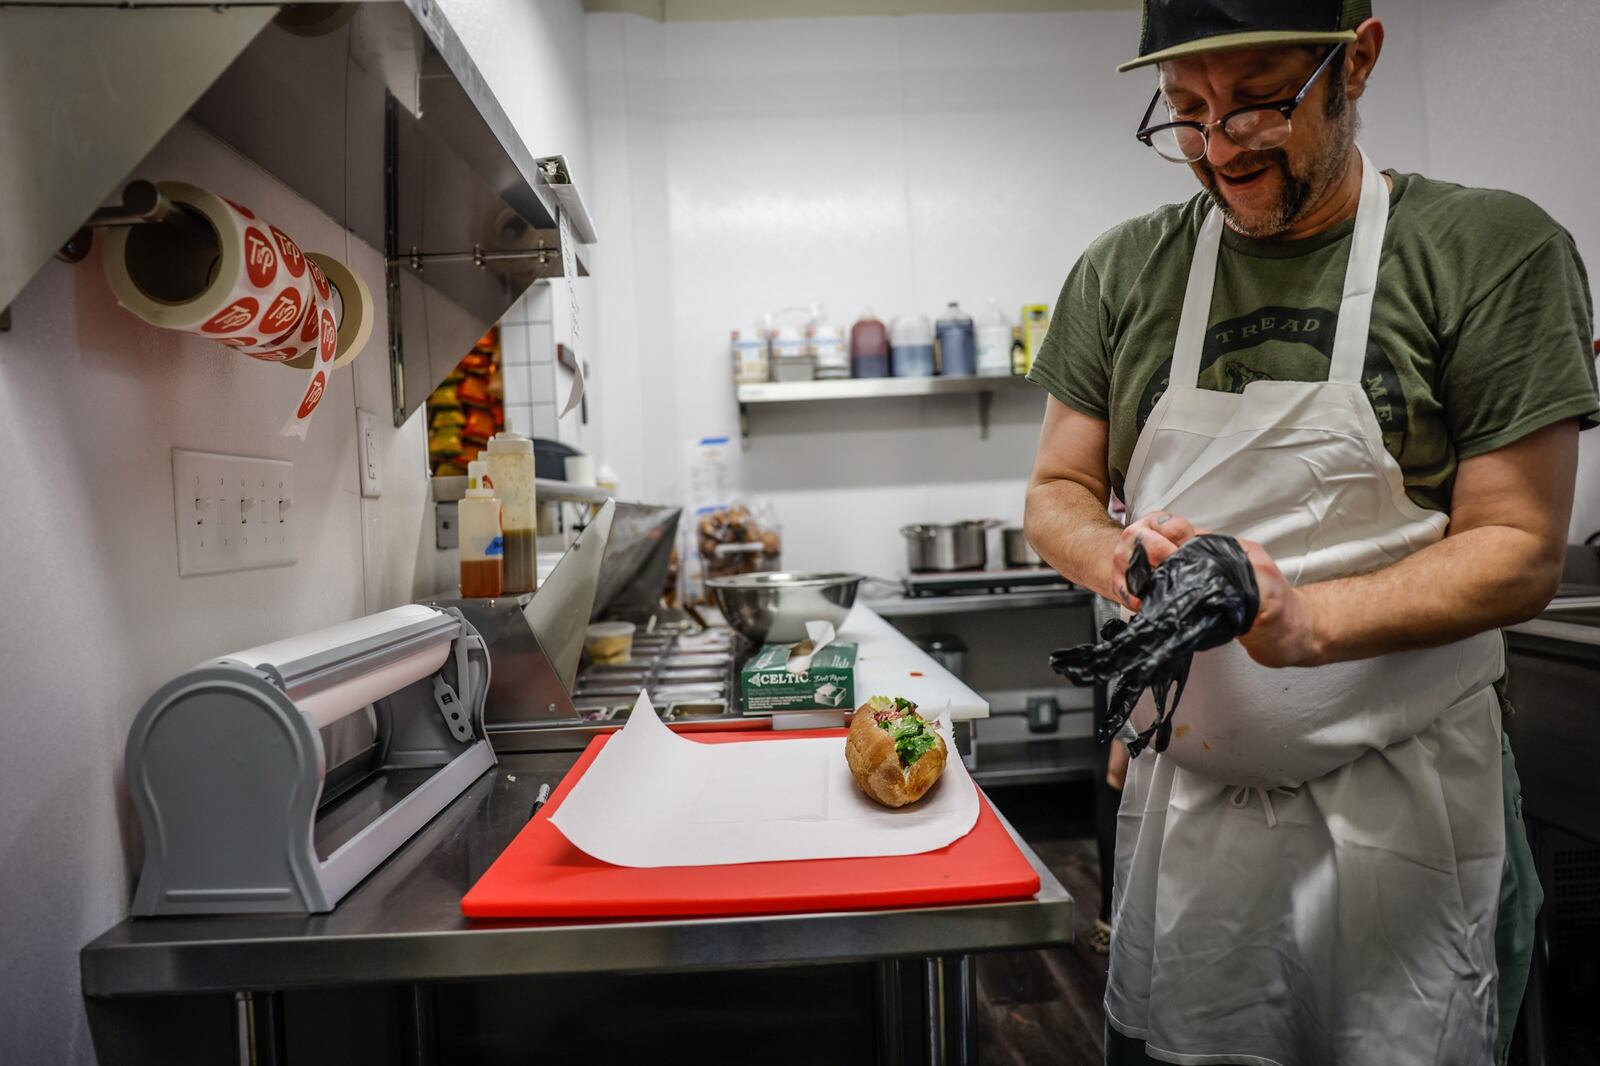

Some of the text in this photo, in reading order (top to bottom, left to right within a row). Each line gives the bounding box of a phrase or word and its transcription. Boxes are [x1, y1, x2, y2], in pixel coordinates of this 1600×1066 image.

[1216, 317, 1320, 344] TREAD
[760, 671, 809, 685] CELTIC
[814, 673, 848, 686] Deli Paper
